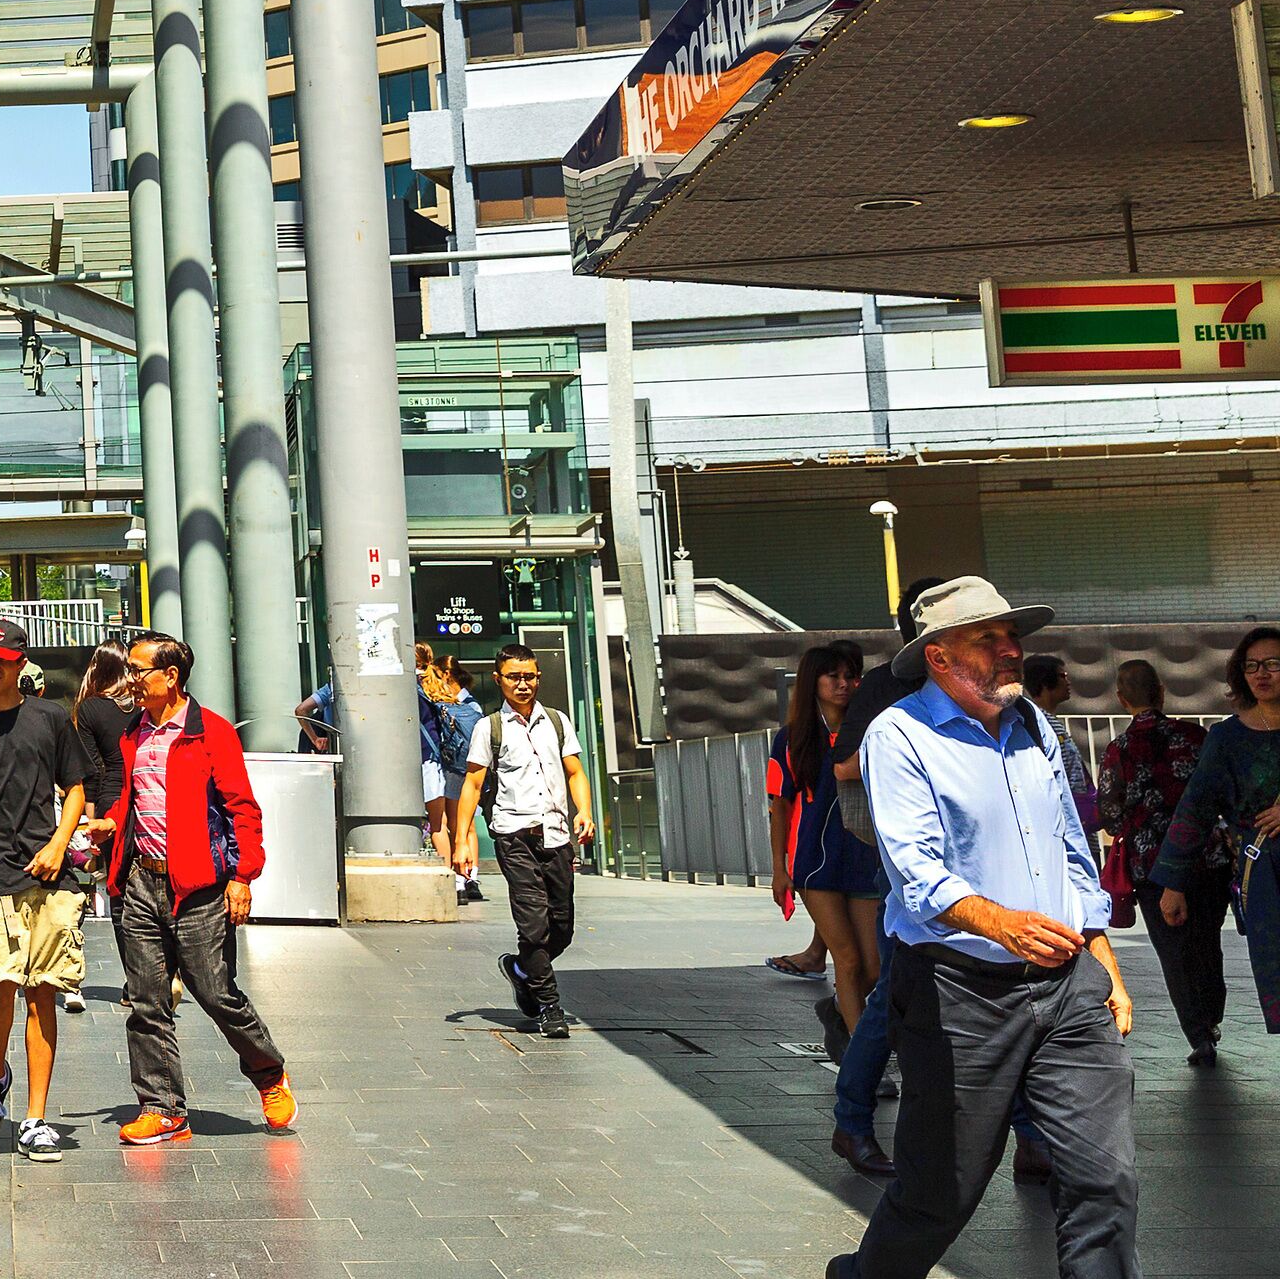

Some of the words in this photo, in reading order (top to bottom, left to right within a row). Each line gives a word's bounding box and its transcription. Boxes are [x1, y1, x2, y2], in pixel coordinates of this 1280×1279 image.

[369, 548, 380, 563] H
[371, 574, 381, 588] P
[450, 596, 467, 607] Lift
[452, 607, 475, 615] Shops
[436, 614, 456, 622] Trains
[462, 614, 483, 622] Buses
